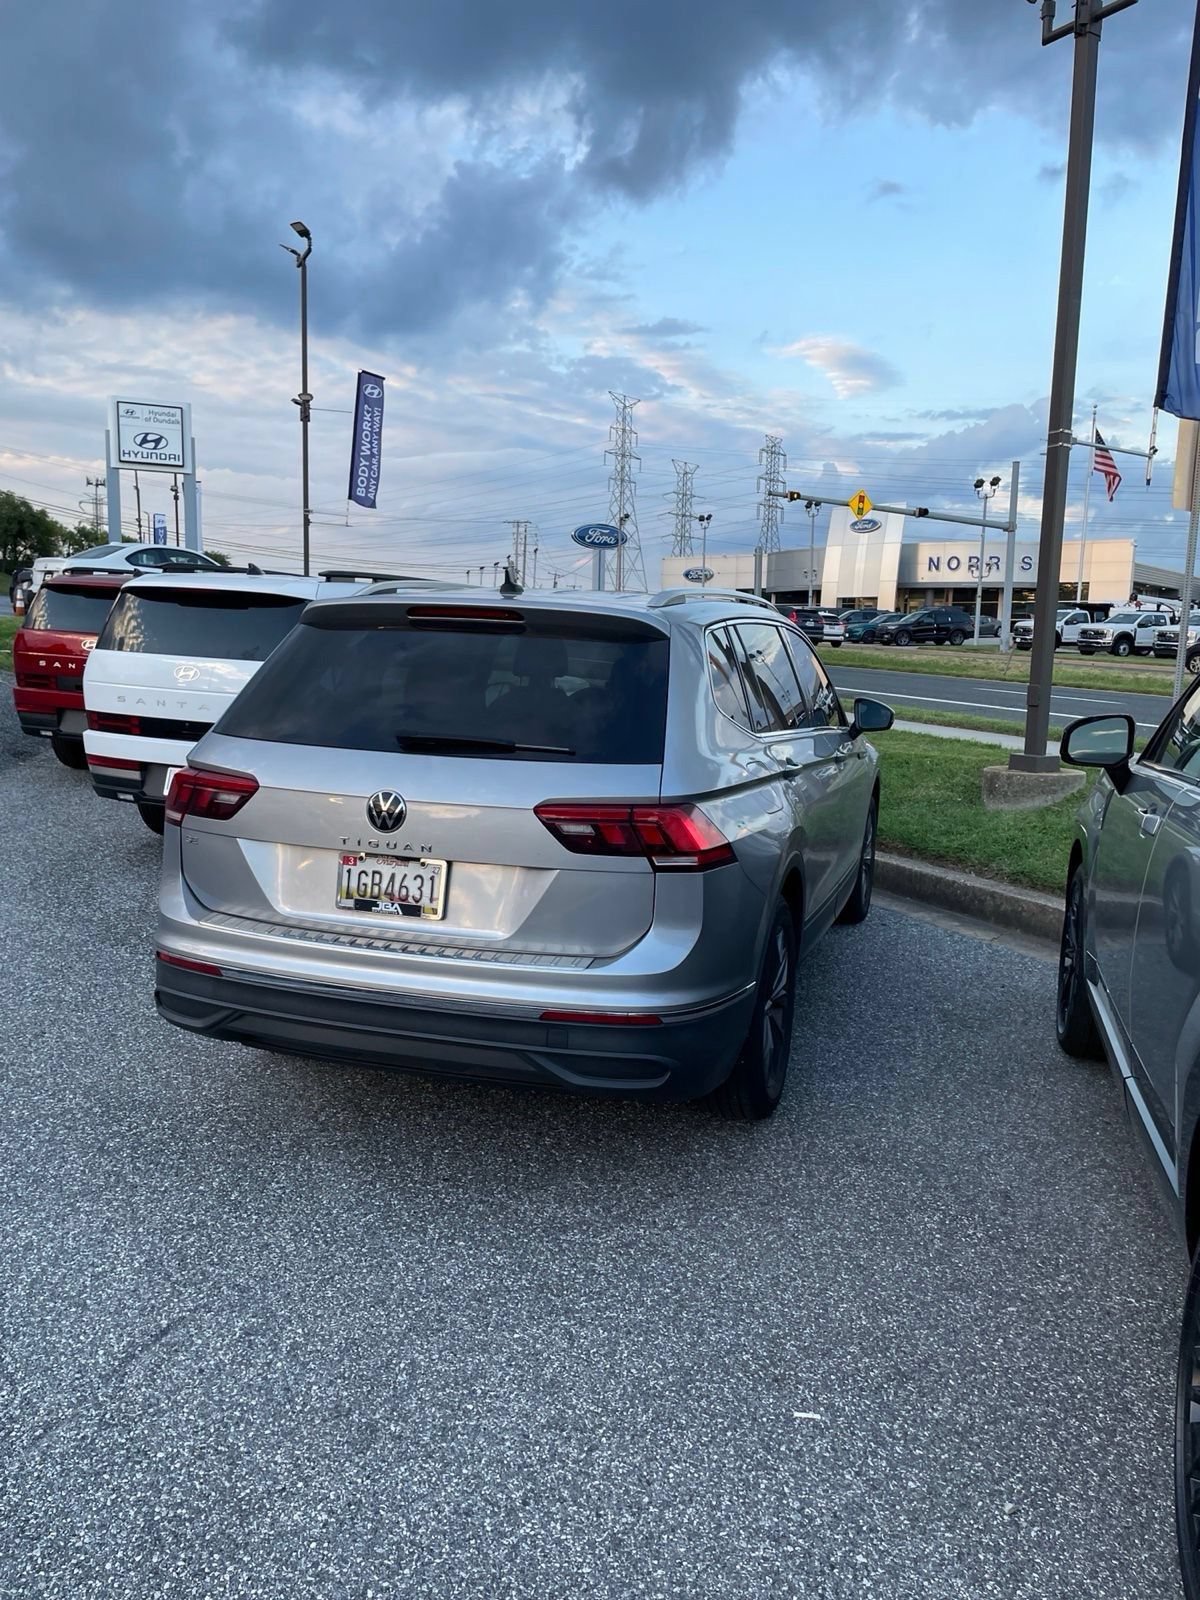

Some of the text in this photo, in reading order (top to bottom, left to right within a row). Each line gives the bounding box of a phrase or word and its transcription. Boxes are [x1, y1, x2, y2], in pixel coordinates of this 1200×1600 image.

[148, 409, 177, 418] Hyundai
[153, 416, 180, 425] Dundalk
[122, 449, 181, 462] HYUNDAI
[367, 478, 377, 500] ANY
[585, 527, 617, 544] Ford
[928, 555, 1033, 572] NORRS
[38, 660, 86, 669] SAN
[116, 695, 210, 711] SANTA
[338, 836, 434, 854] TIGUAN
[348, 857, 354, 865] 3
[345, 867, 436, 904] 1GB4631
[371, 901, 403, 915] JBA
